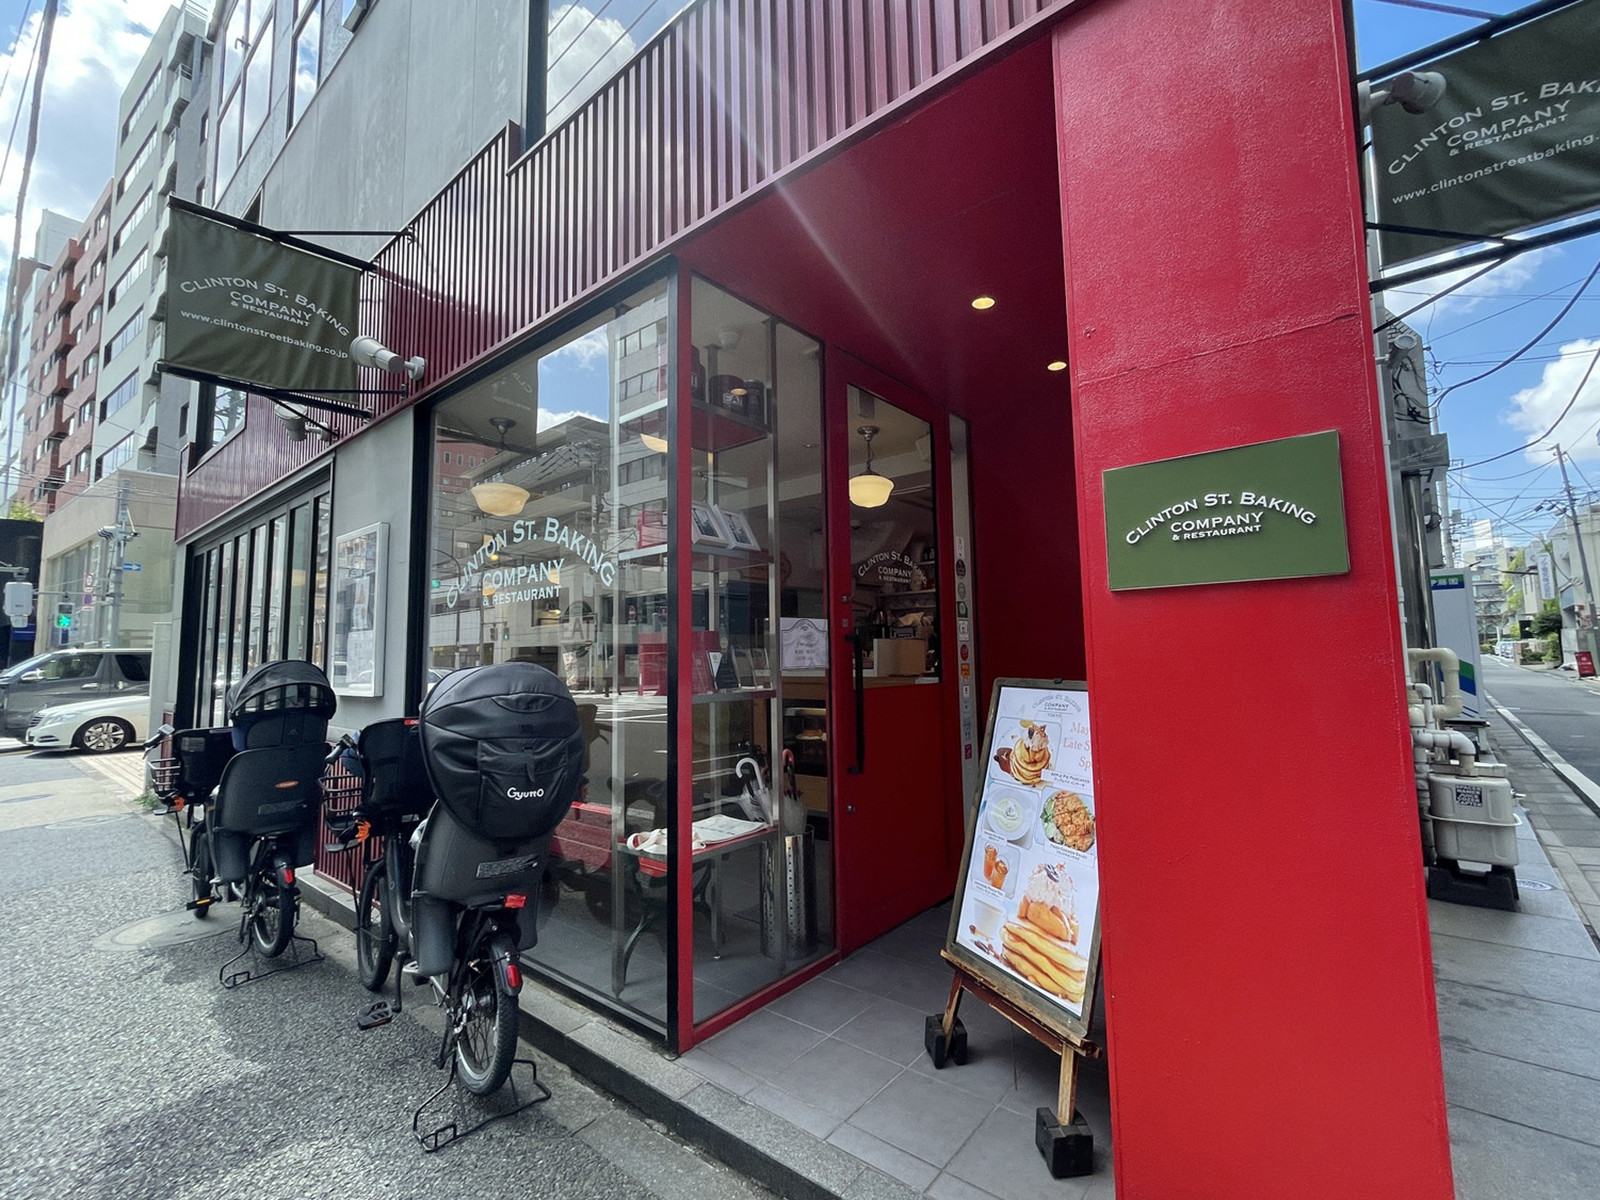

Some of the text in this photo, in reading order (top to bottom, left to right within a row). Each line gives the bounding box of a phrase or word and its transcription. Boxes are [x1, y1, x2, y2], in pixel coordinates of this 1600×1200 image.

[1388, 107, 1482, 175] CLINTON
[1491, 92, 1528, 111] ST.
[1447, 100, 1570, 147] COMPANY
[1449, 114, 1568, 156] & RESTAURANT
[180, 277, 350, 337] CLINTON ST. BAKING
[229, 290, 312, 320] COMPANY
[242, 303, 310, 326] RESTAURANT
[180, 310, 348, 359] www.clintonstreetbaking.co.jp
[1125, 492, 1316, 545] CLINTON ST. BAKING
[1170, 511, 1264, 533] COMPANY
[1183, 524, 1262, 540] RESTAURANT
[447, 517, 616, 608] CLINTON ST. BAKING
[482, 558, 564, 589] COMPANY
[858, 551, 889, 576] CLINTON
[878, 566, 912, 577] COMPANY
[483, 585, 562, 606] & RESTAURANT
[1063, 737, 1082, 749] Late
